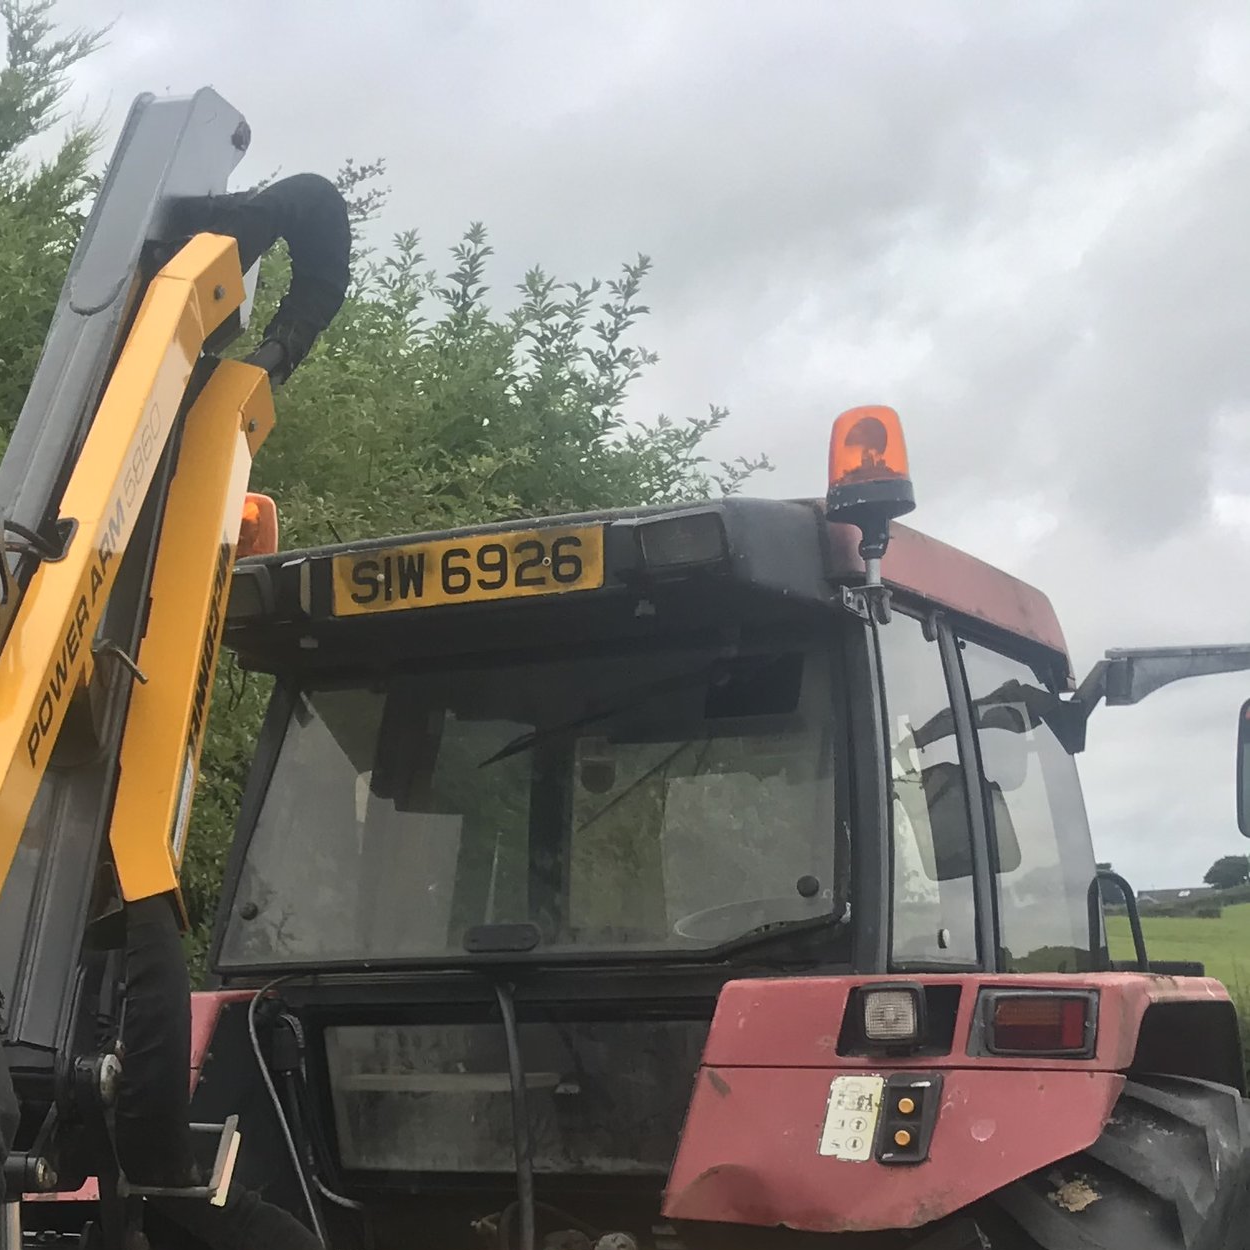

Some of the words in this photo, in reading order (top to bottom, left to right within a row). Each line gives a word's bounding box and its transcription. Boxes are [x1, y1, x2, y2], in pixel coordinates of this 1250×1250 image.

[27, 595, 90, 768] POWER
[90, 498, 125, 606] ARM
[122, 403, 162, 509] 5860
[350, 552, 425, 605] SIW
[441, 536, 583, 595] 6926
